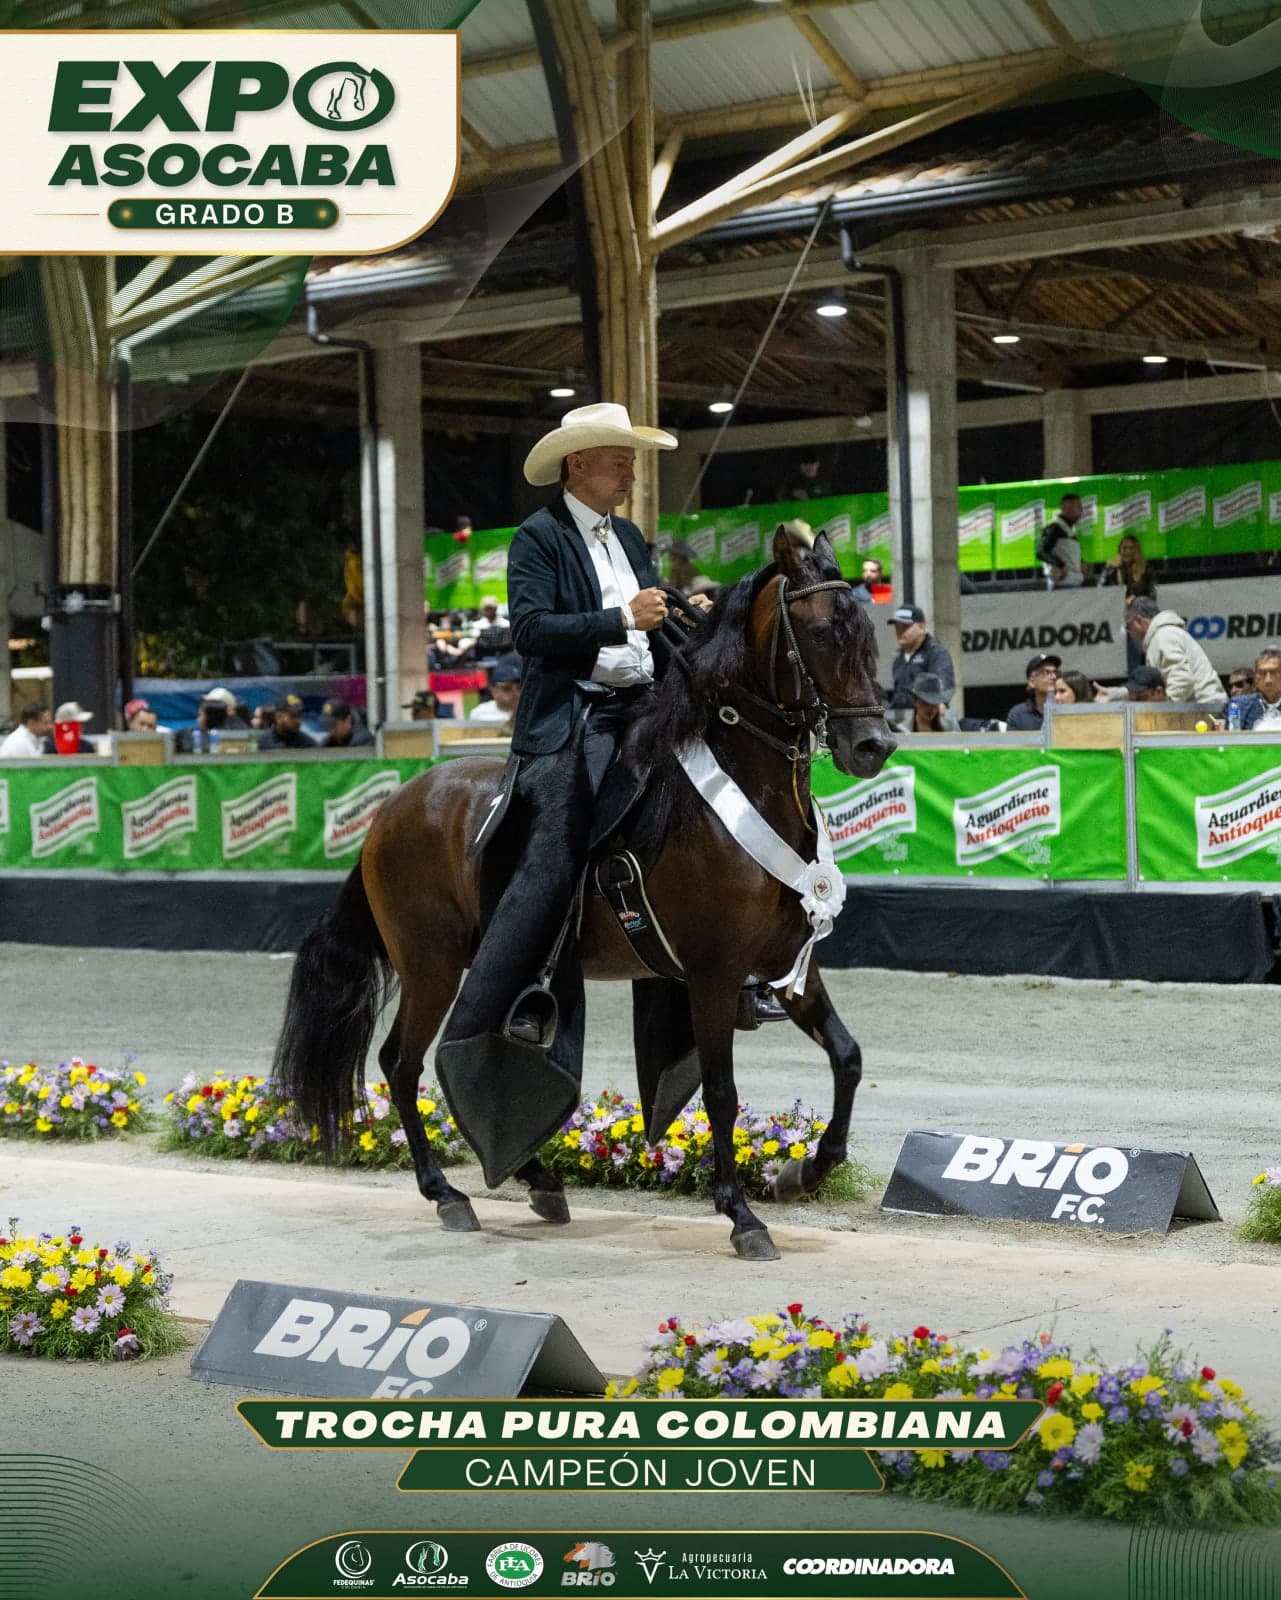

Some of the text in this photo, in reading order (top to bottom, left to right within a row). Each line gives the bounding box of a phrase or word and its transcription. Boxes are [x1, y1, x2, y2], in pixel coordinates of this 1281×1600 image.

[827, 786, 904, 828] Aguardiente
[965, 787, 1049, 829] Aguardiente
[966, 801, 1050, 845] Antioqueño
[1208, 789, 1281, 829] Aguardie
[1051, 1193, 1105, 1224] F.C.
